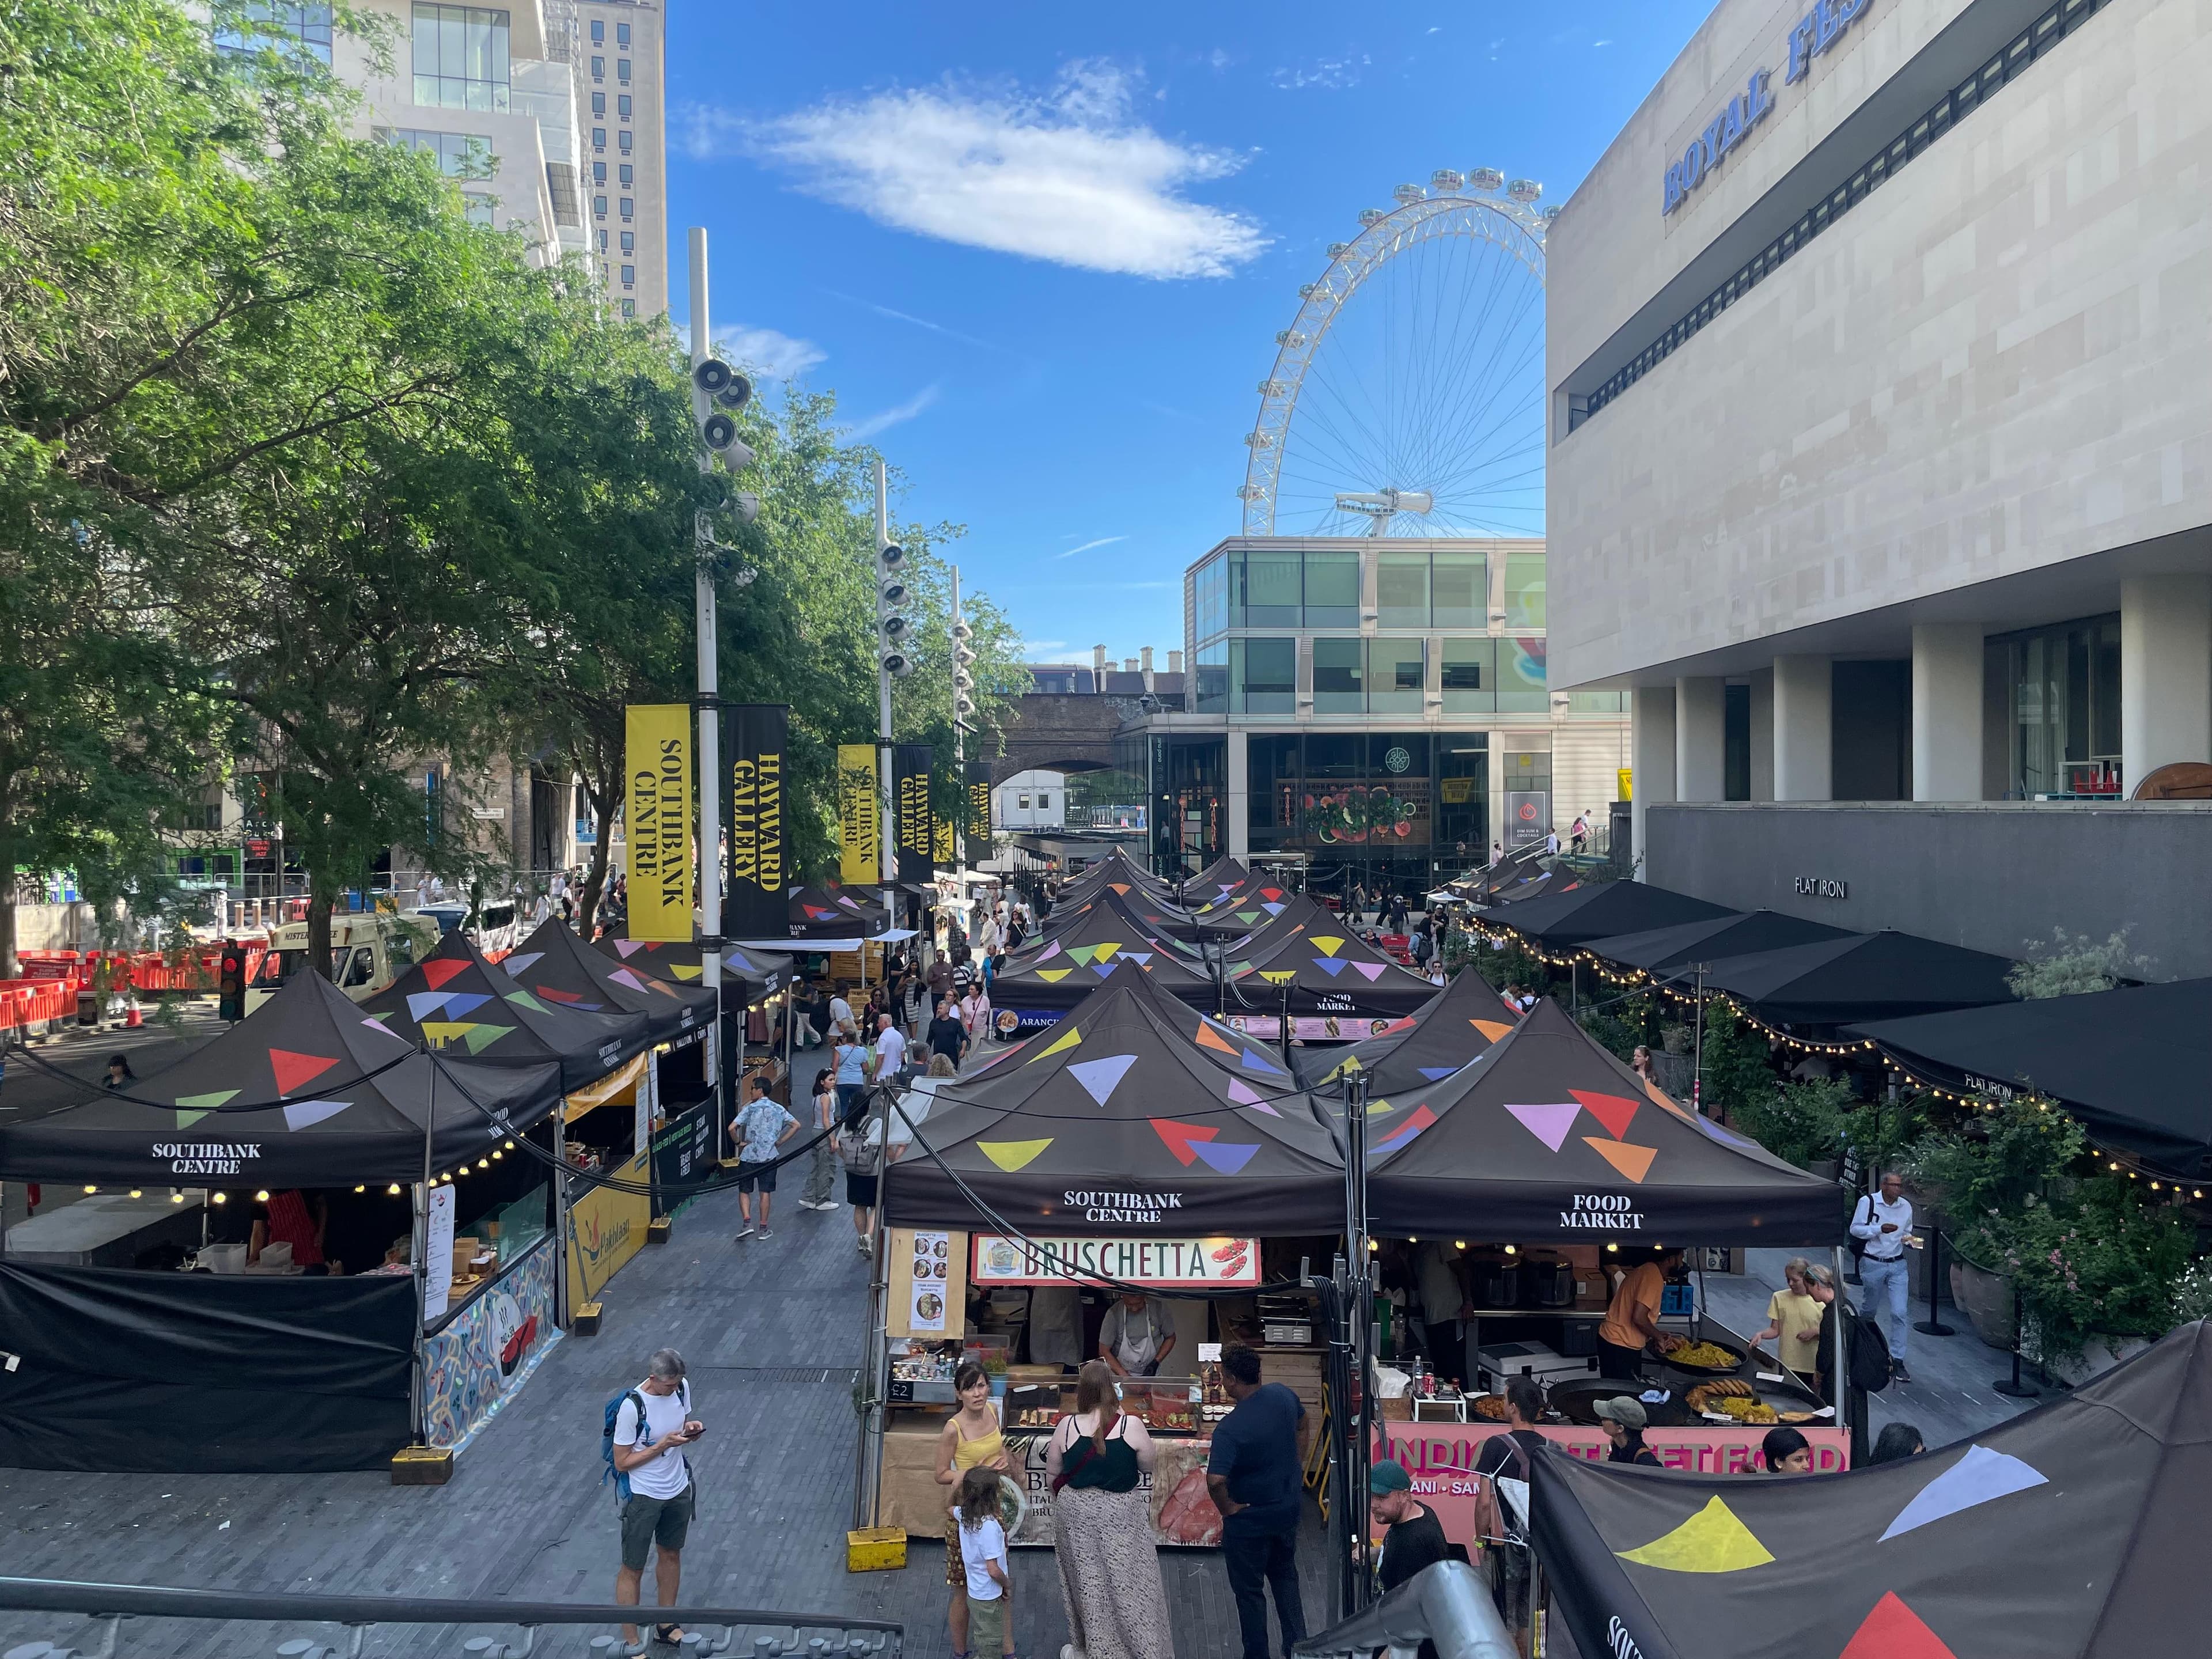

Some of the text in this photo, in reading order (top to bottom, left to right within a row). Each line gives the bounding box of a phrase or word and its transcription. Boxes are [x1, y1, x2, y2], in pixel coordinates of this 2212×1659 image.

[1662, 0, 1868, 217] ROYAL FES
[635, 771, 657, 877] CENTRE
[661, 740, 683, 908] SOUTHBANK
[734, 759, 756, 884] GALLERY
[759, 753, 781, 892] HAYWARD
[901, 777, 914, 850] GALLERY
[915, 773, 929, 855] HAYWARD
[1796, 877, 1844, 898] FLAT IRON
[1964, 1074, 2012, 1098] FLAT IRON
[153, 1143, 262, 1158] SOUTHBANK
[172, 1160, 241, 1174] CENTRE
[1065, 1191, 1182, 1209] SOUTHBANK
[1573, 1194, 1631, 1211] FOOD
[1086, 1207, 1162, 1224] CENTRE
[1560, 1211, 1644, 1229] MARKET
[1025, 1243, 1206, 1277] BRUSCHETTA
[892, 1384, 908, 1397] £2
